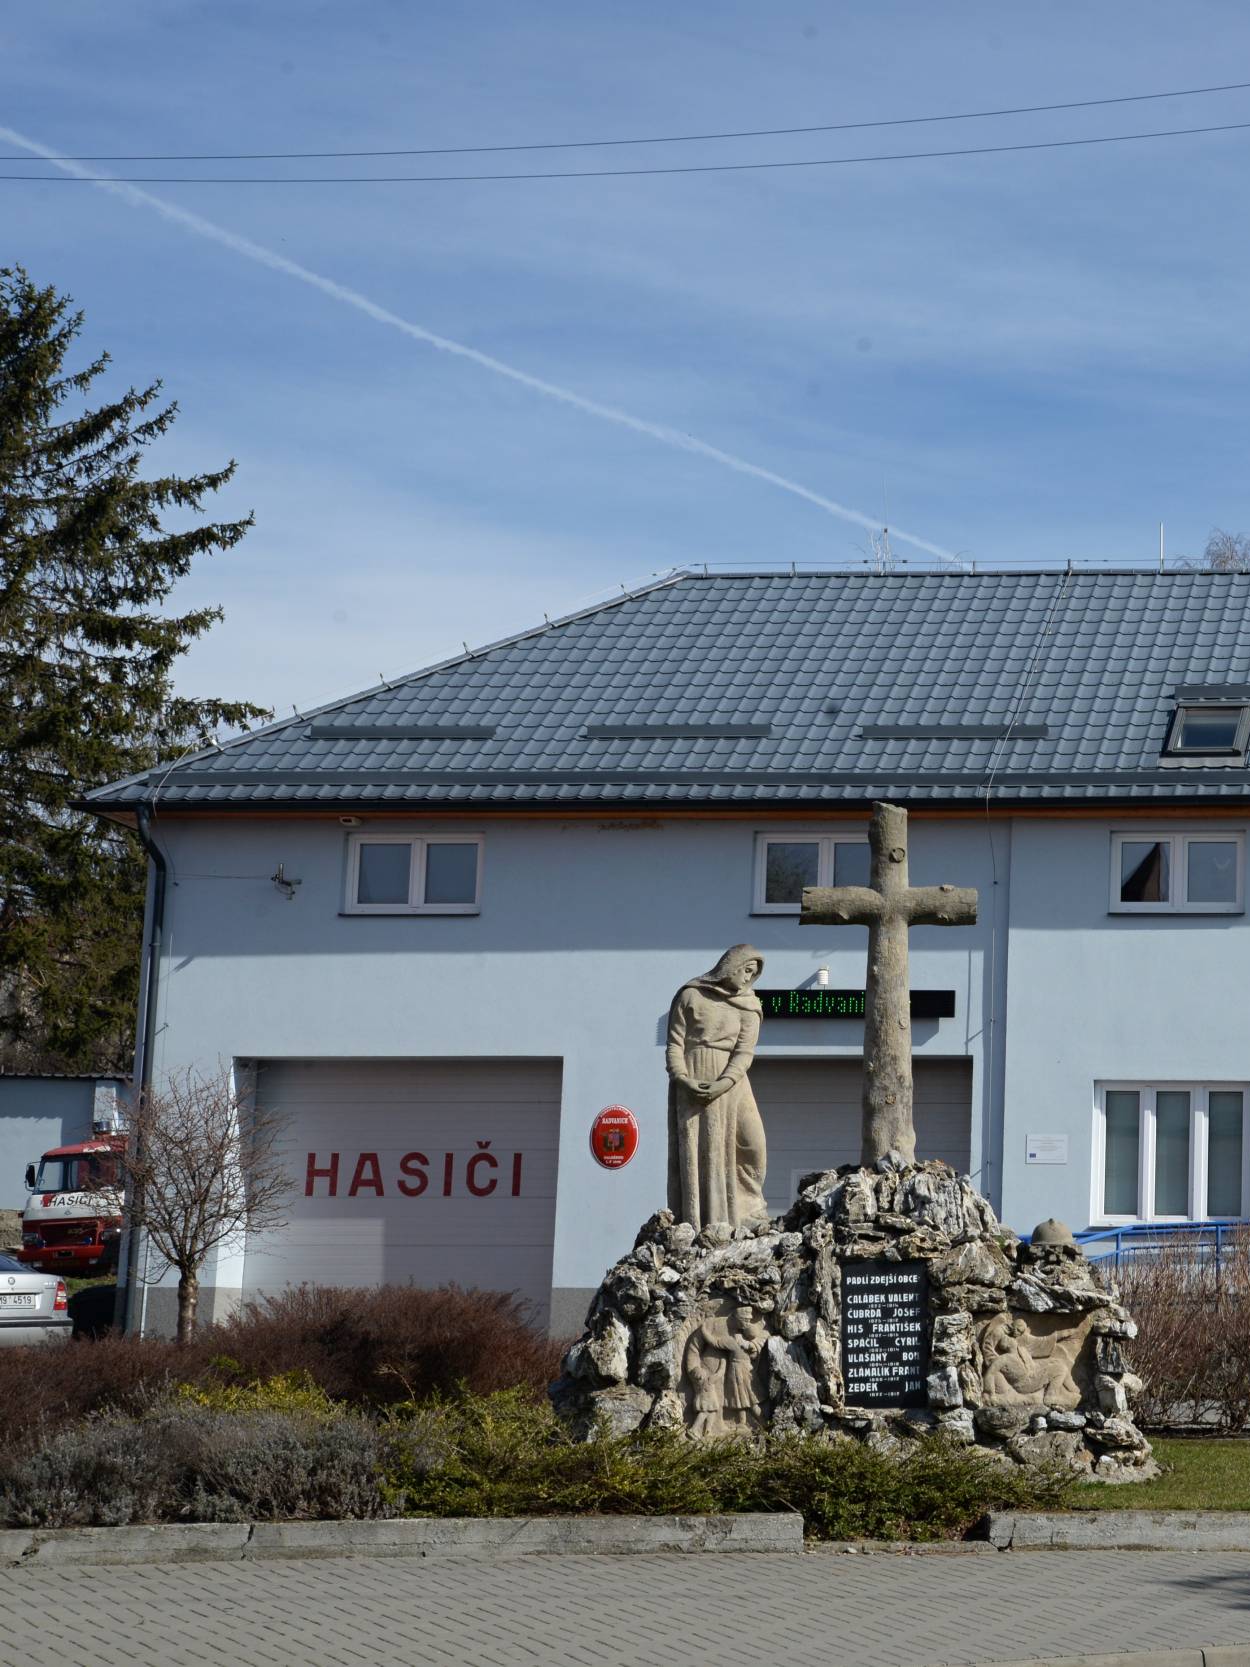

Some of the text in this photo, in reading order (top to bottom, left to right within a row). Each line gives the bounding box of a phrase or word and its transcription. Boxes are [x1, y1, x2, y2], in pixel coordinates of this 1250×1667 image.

[789, 991, 865, 1013] Radvani
[304, 1141, 522, 1197] HASIČI
[846, 1274, 869, 1285] PADLÍ
[870, 1274, 897, 1287] ZDEJŠÍ
[847, 1307, 920, 1319] ČUBRDA JOSEF
[872, 1321, 921, 1333] FRANTIŠEK
[894, 1336, 920, 1347] CYRIL
[904, 1380, 921, 1393] JAN
